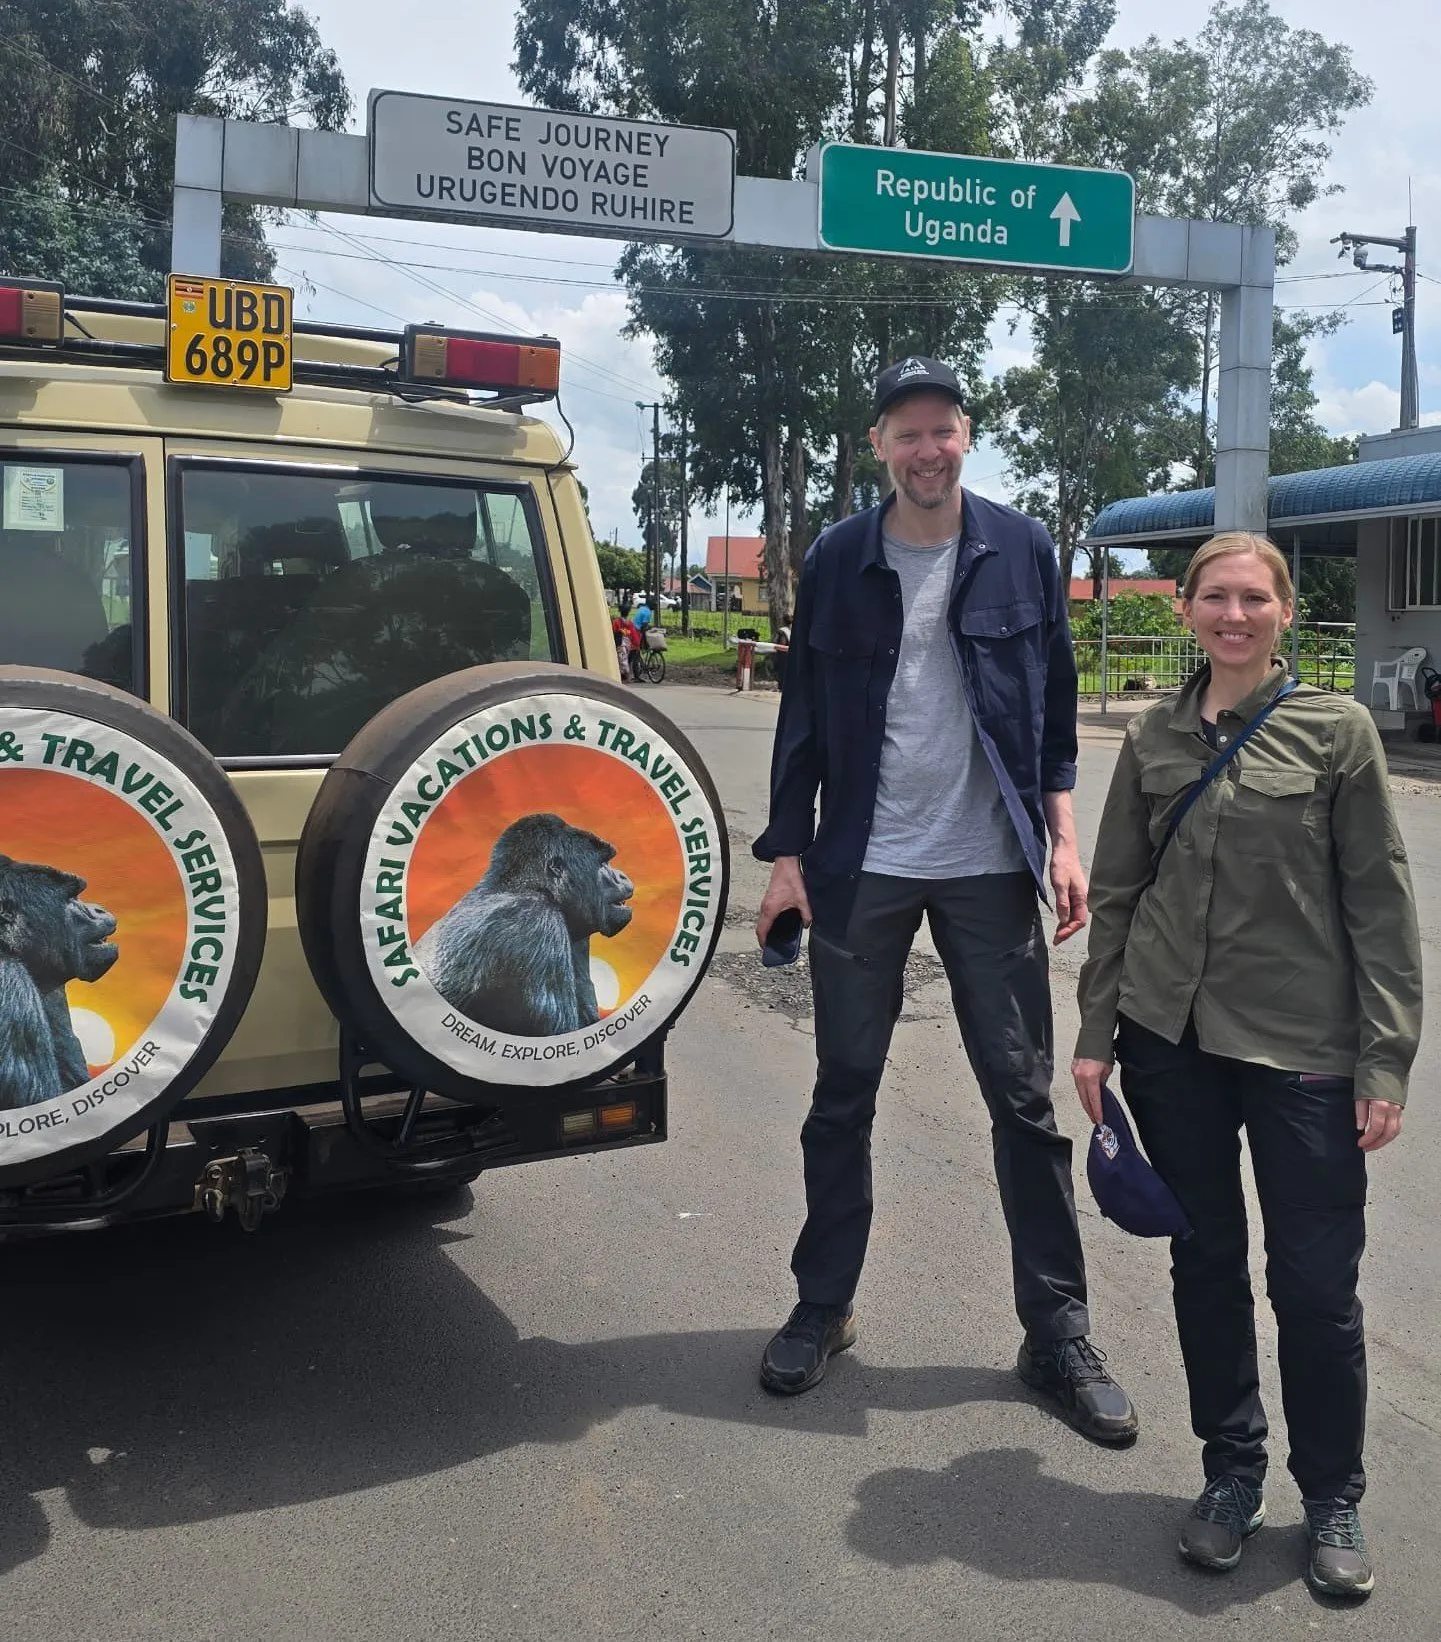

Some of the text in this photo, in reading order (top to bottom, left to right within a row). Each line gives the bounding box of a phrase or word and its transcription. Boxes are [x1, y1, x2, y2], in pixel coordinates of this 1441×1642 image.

[446, 110, 671, 158] SAFE JOURNEY
[467, 145, 650, 189] BON VOYAGE
[876, 169, 1037, 210] Republic of
[416, 173, 695, 225] URUGENDO RUHIRE
[904, 210, 1009, 246] Uganda
[209, 286, 285, 335] UBD
[185, 333, 286, 382] 689P
[40, 733, 184, 832] TRAVEL
[173, 829, 226, 1004] SERVICES
[374, 712, 712, 988] SAFARI VACATIONS & TRAVEL SERVICES
[440, 994, 653, 1061] DREAM, EXPLORE, DISCOVER
[71, 1040, 161, 1117] DISCOVER
